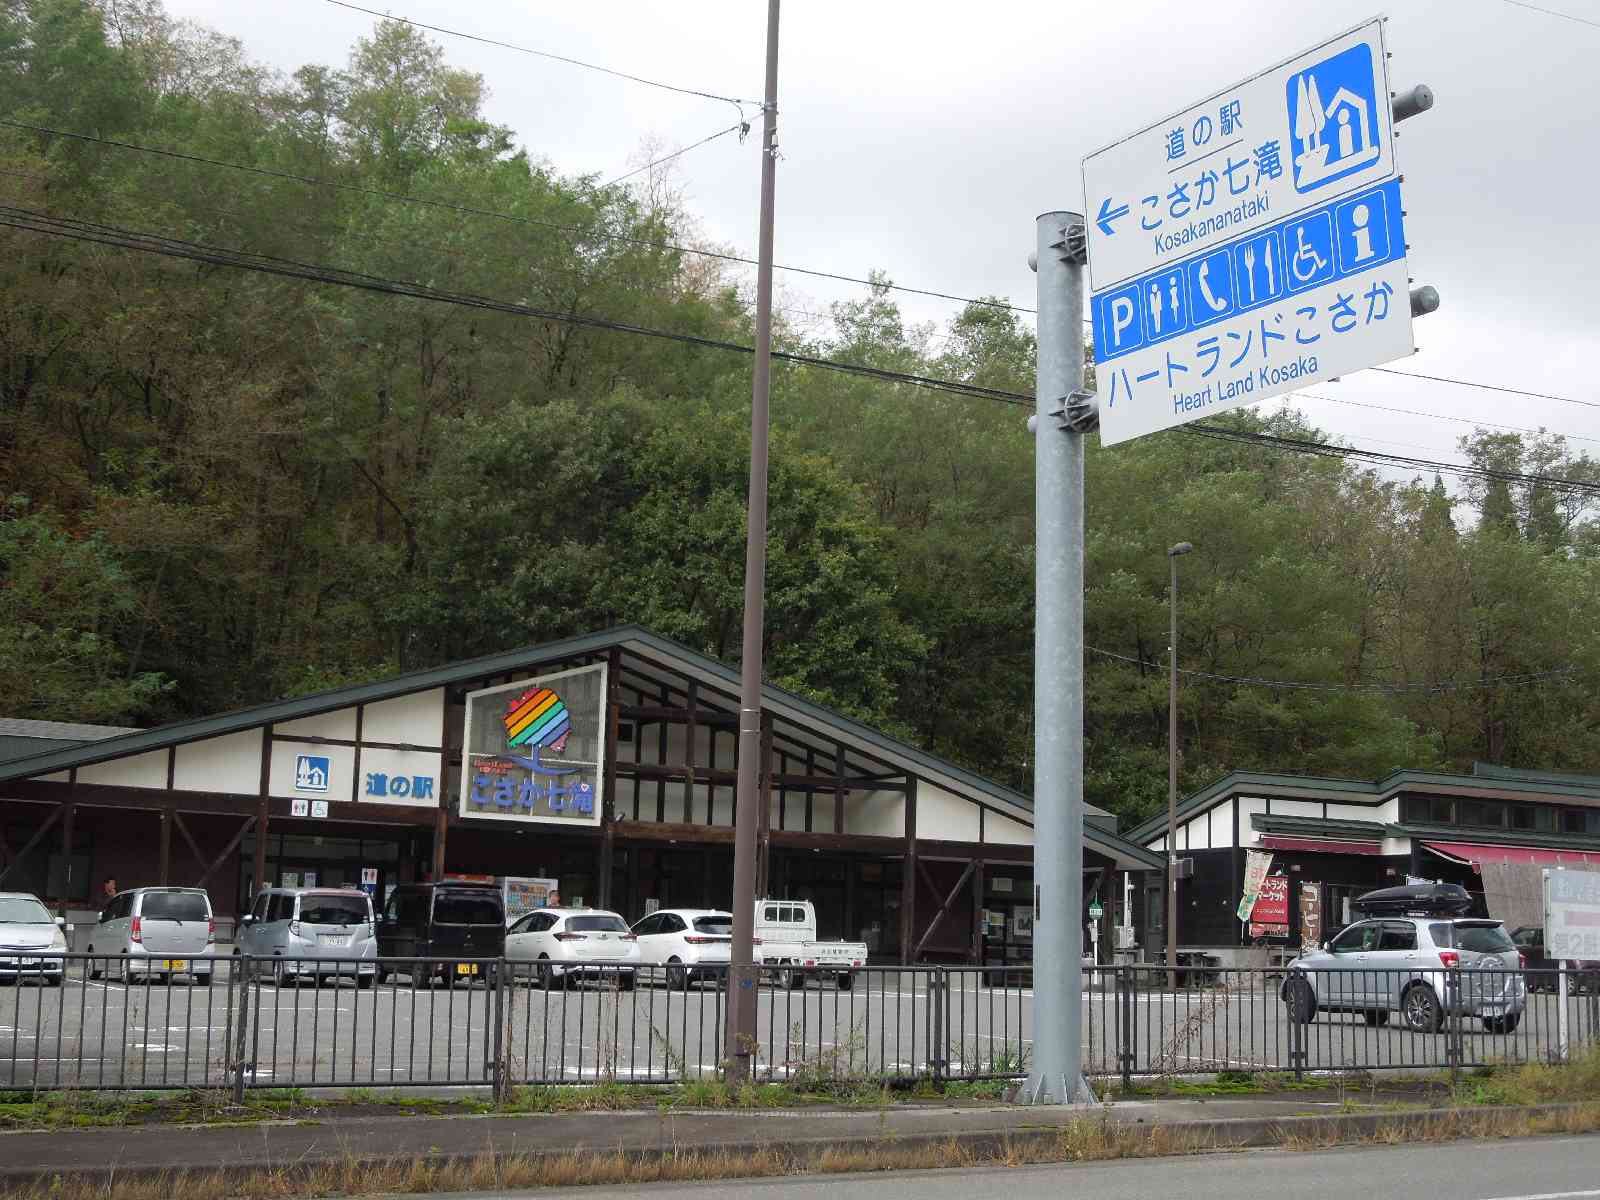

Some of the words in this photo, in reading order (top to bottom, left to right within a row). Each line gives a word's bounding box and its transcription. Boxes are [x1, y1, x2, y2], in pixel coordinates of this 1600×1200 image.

[1165, 100, 1243, 160] 道の駅
[1140, 141, 1283, 231] こさか七滝
[1154, 192, 1270, 255] Kosakananataki
[1108, 281, 1394, 407] ハートランドこさか
[1112, 296, 1133, 346] P
[1174, 389, 1214, 415] Heart
[1218, 371, 1254, 401] Land
[1258, 354, 1319, 388] Kosaka
[366, 773, 434, 799] 道の駅
